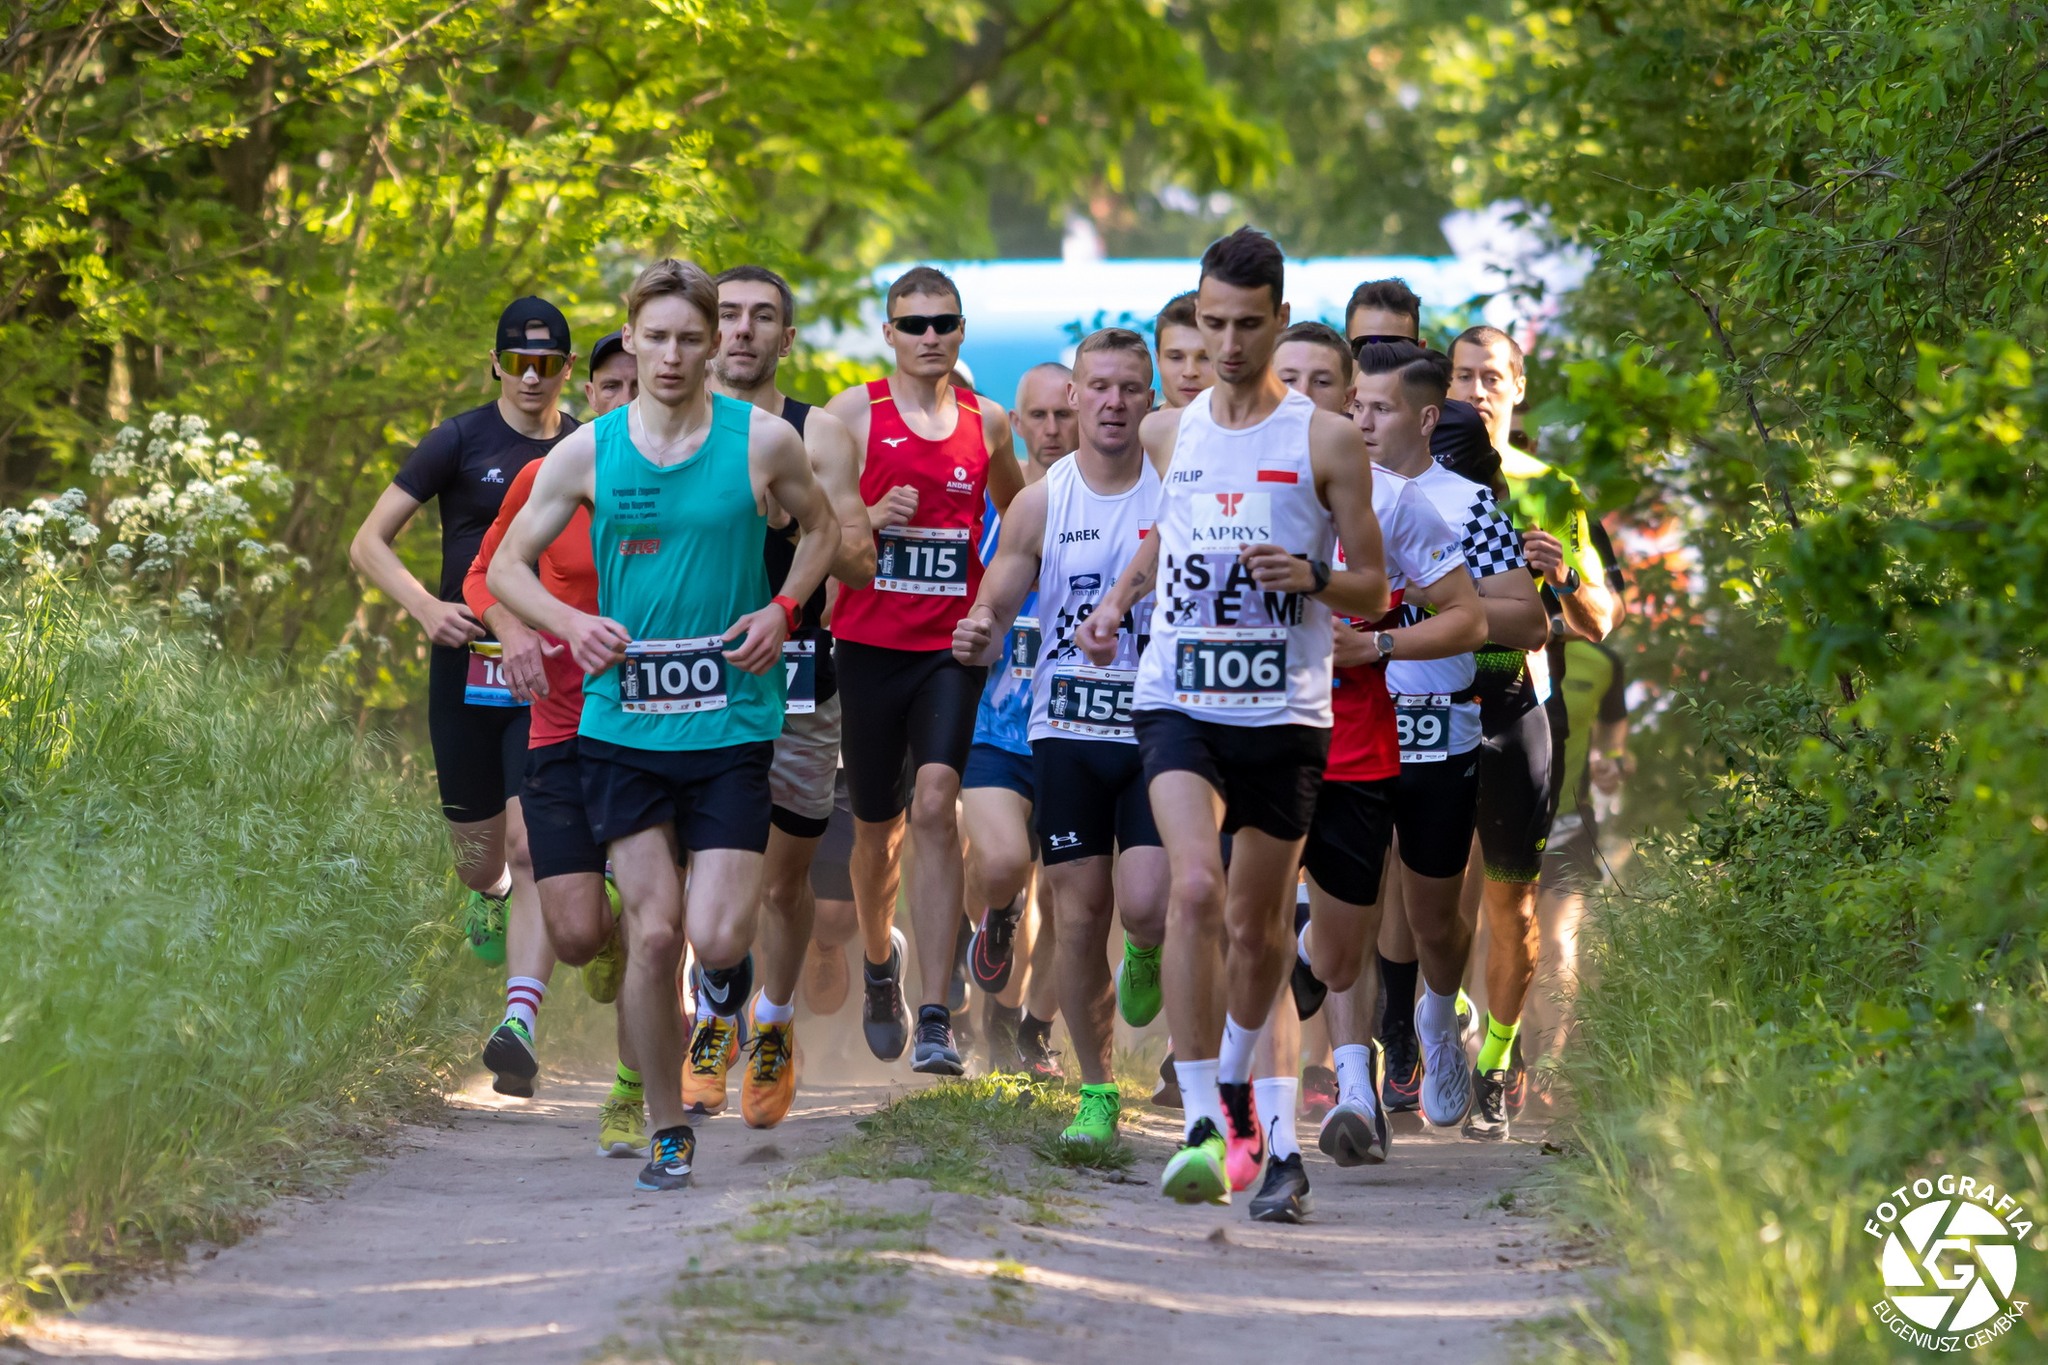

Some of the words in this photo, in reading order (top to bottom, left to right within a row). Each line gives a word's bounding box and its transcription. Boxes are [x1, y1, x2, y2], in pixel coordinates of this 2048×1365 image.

[947, 481, 972, 491] ANDRE
[1173, 470, 1203, 483] FILIP
[1059, 529, 1100, 544] DAREK
[1192, 526, 1269, 541] KAPRYS
[905, 546, 957, 578] 115
[1190, 591, 1297, 626] TEAM
[641, 658, 719, 695] 100
[1199, 650, 1281, 688] 106
[1075, 686, 1134, 722] 155
[1396, 714, 1442, 747] 89
